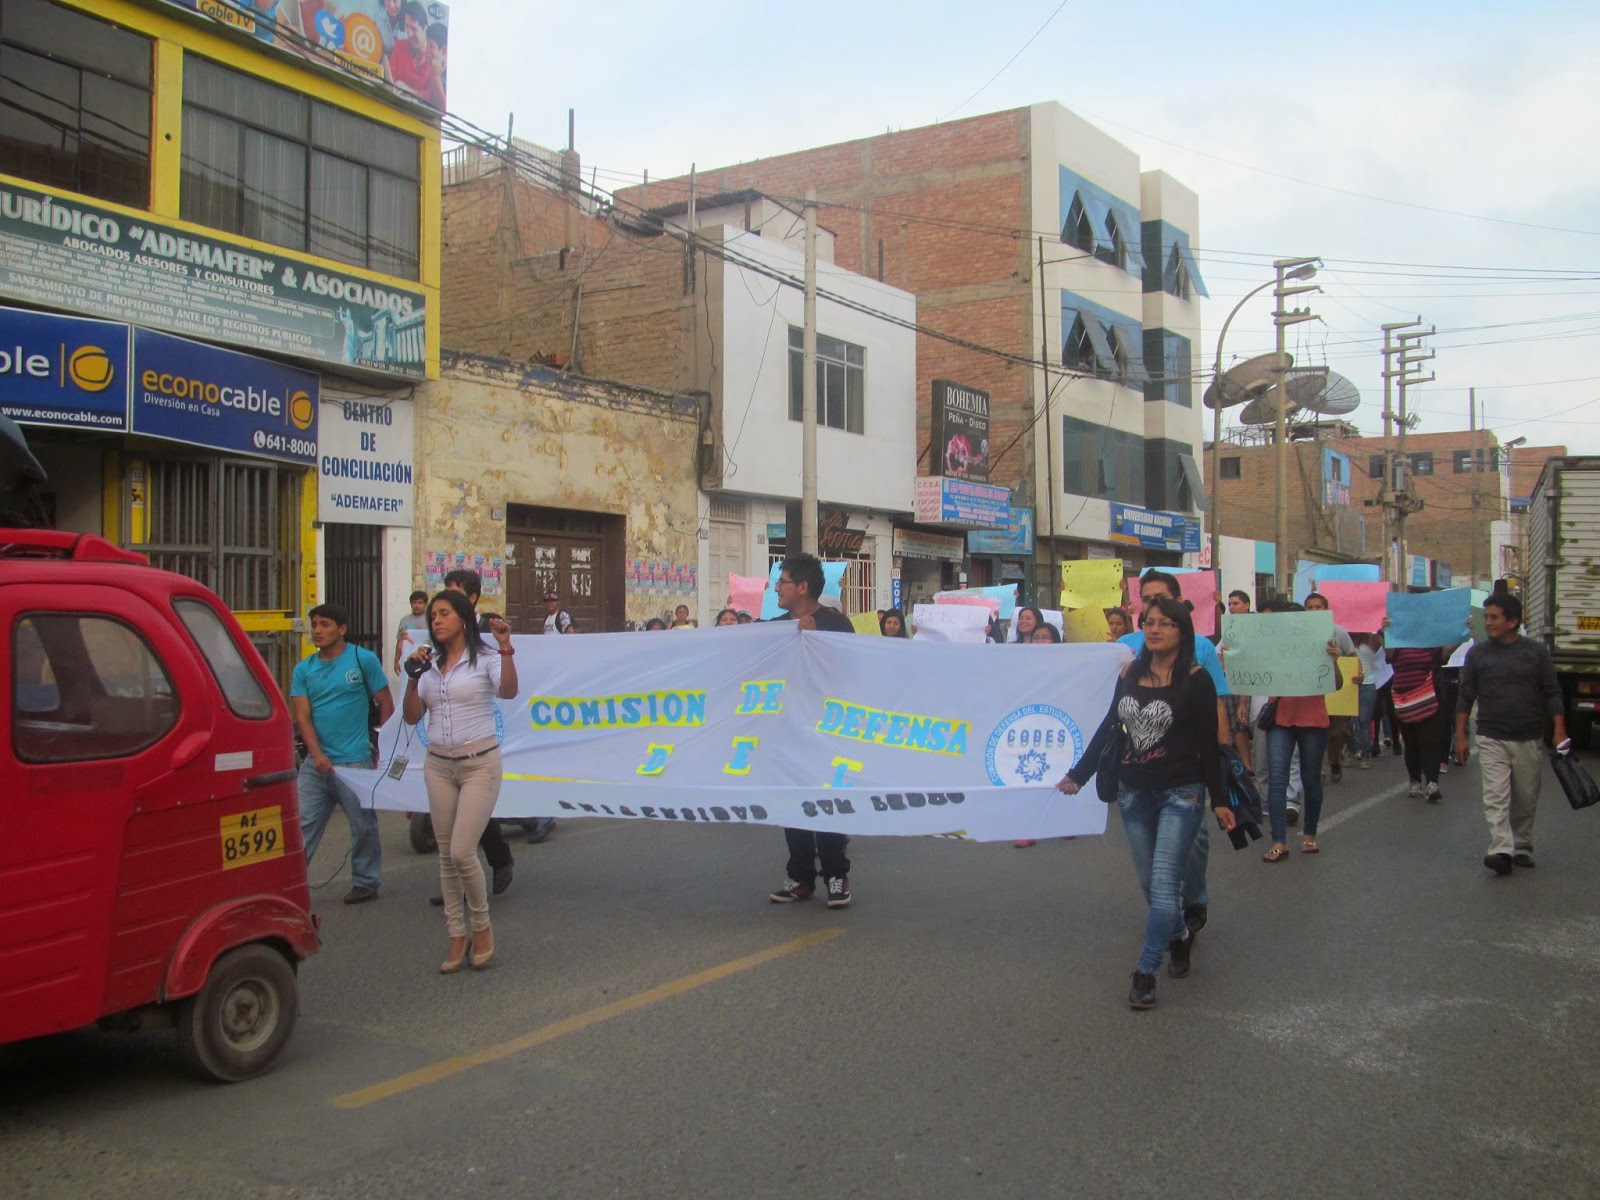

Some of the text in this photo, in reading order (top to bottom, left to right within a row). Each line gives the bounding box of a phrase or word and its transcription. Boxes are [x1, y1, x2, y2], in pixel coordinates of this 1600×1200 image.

[201, 1, 233, 22] Cable
[0, 190, 120, 243] URÍDICO
[281, 266, 298, 289] &
[302, 271, 413, 317] ASOCIADOS
[63, 236, 275, 296] ABOGADOS ASESORES Y CONSULTORES
[9, 271, 85, 297] SANEAMIENTO
[89, 289, 102, 300] DE
[107, 293, 172, 315] PROPIEDADES
[177, 309, 199, 321] ANTE
[203, 314, 219, 325] LOS
[222, 318, 269, 336] REGISTROS
[143, 370, 281, 416] econocable
[144, 392, 220, 417] Diversión en Casa
[946, 386, 988, 415] BOHEMIA
[2, 405, 123, 425] www.econocable.com
[343, 401, 392, 426] CENTRO
[266, 434, 316, 457] 641-8000
[361, 431, 376, 452] DE
[322, 456, 412, 484] CONCILIACIÓN
[531, 692, 706, 727] COMISION
[743, 682, 784, 713] DE
[818, 700, 967, 755] DEFENSA
[989, 735, 998, 746] DE
[994, 710, 1021, 736] DEFENSA
[1022, 705, 1037, 715] DEL
[1039, 705, 1077, 733] ESTUDIANTE
[224, 828, 277, 861] 8599
